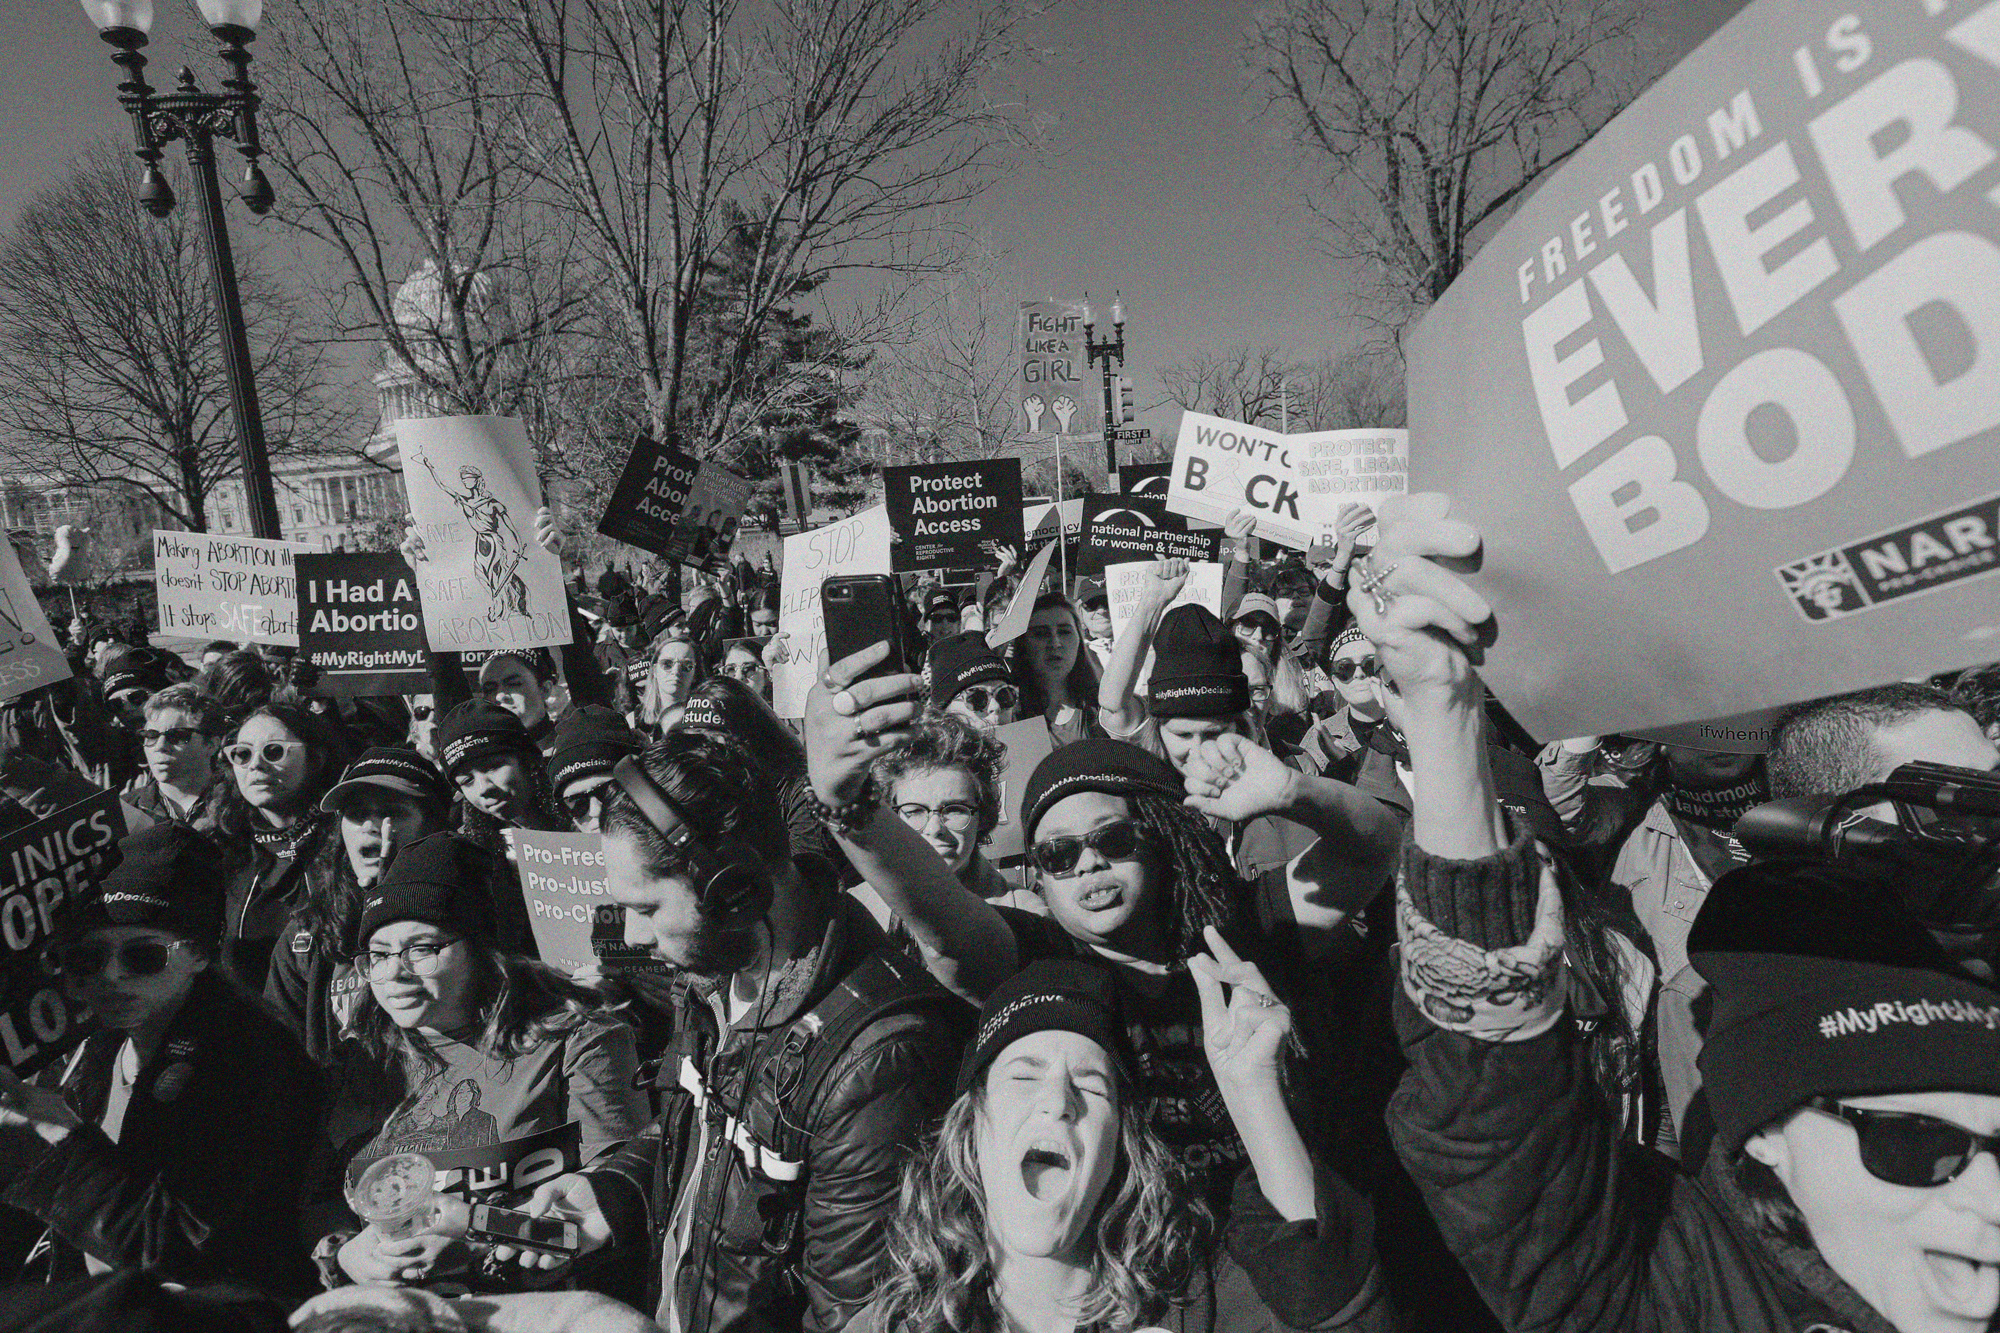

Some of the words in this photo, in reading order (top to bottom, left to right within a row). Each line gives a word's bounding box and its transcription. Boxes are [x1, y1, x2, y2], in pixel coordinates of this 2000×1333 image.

[1517, 89, 1763, 304] FREEDOM
[1794, 14, 1872, 98] IS
[1028, 313, 1081, 333] FIGHT
[1026, 338, 1057, 353] LIKE
[1058, 340, 1069, 352] A
[1023, 360, 1080, 383] GIRL
[1117, 430, 1141, 439] FIRST
[1196, 425, 1278, 462] WON'T
[1309, 438, 1396, 458] PROTECT
[653, 455, 695, 486] Prot
[910, 473, 982, 493] Protect
[1309, 474, 1404, 494] ABORTION
[635, 496, 680, 525] Acce
[912, 494, 998, 515] Abortion
[424, 521, 464, 544] AVE
[914, 518, 981, 536] Access
[1091, 523, 1140, 537] national
[1144, 529, 1211, 547] partnership
[157, 536, 200, 570] Making
[207, 541, 276, 567] ABORTION
[806, 520, 865, 570] STOP
[1090, 536, 1108, 547] for
[1110, 540, 1153, 552] women
[1155, 542, 1165, 553] &
[1168, 543, 1209, 559] families
[1860, 516, 1997, 580] NAR
[209, 569, 247, 592] STOP
[250, 573, 297, 600] ABORTI
[309, 580, 317, 603] I
[326, 579, 373, 603] Had
[392, 579, 413, 602] A
[424, 577, 473, 602] SAFE
[219, 601, 266, 636] SAFE
[261, 609, 298, 636] aborti
[310, 608, 418, 633] Abortio
[438, 609, 569, 645] ABORTION
[0, 658, 41, 687] ESS
[684, 710, 724, 725] stude
[1700, 724, 1770, 741] ifwhenh
[522, 843, 605, 867] Pro-Free
[527, 871, 612, 895] Pro-Just
[1, 852, 102, 951] OPE
[533, 899, 627, 924] Pro-Choi
[0, 988, 95, 1068] LO
